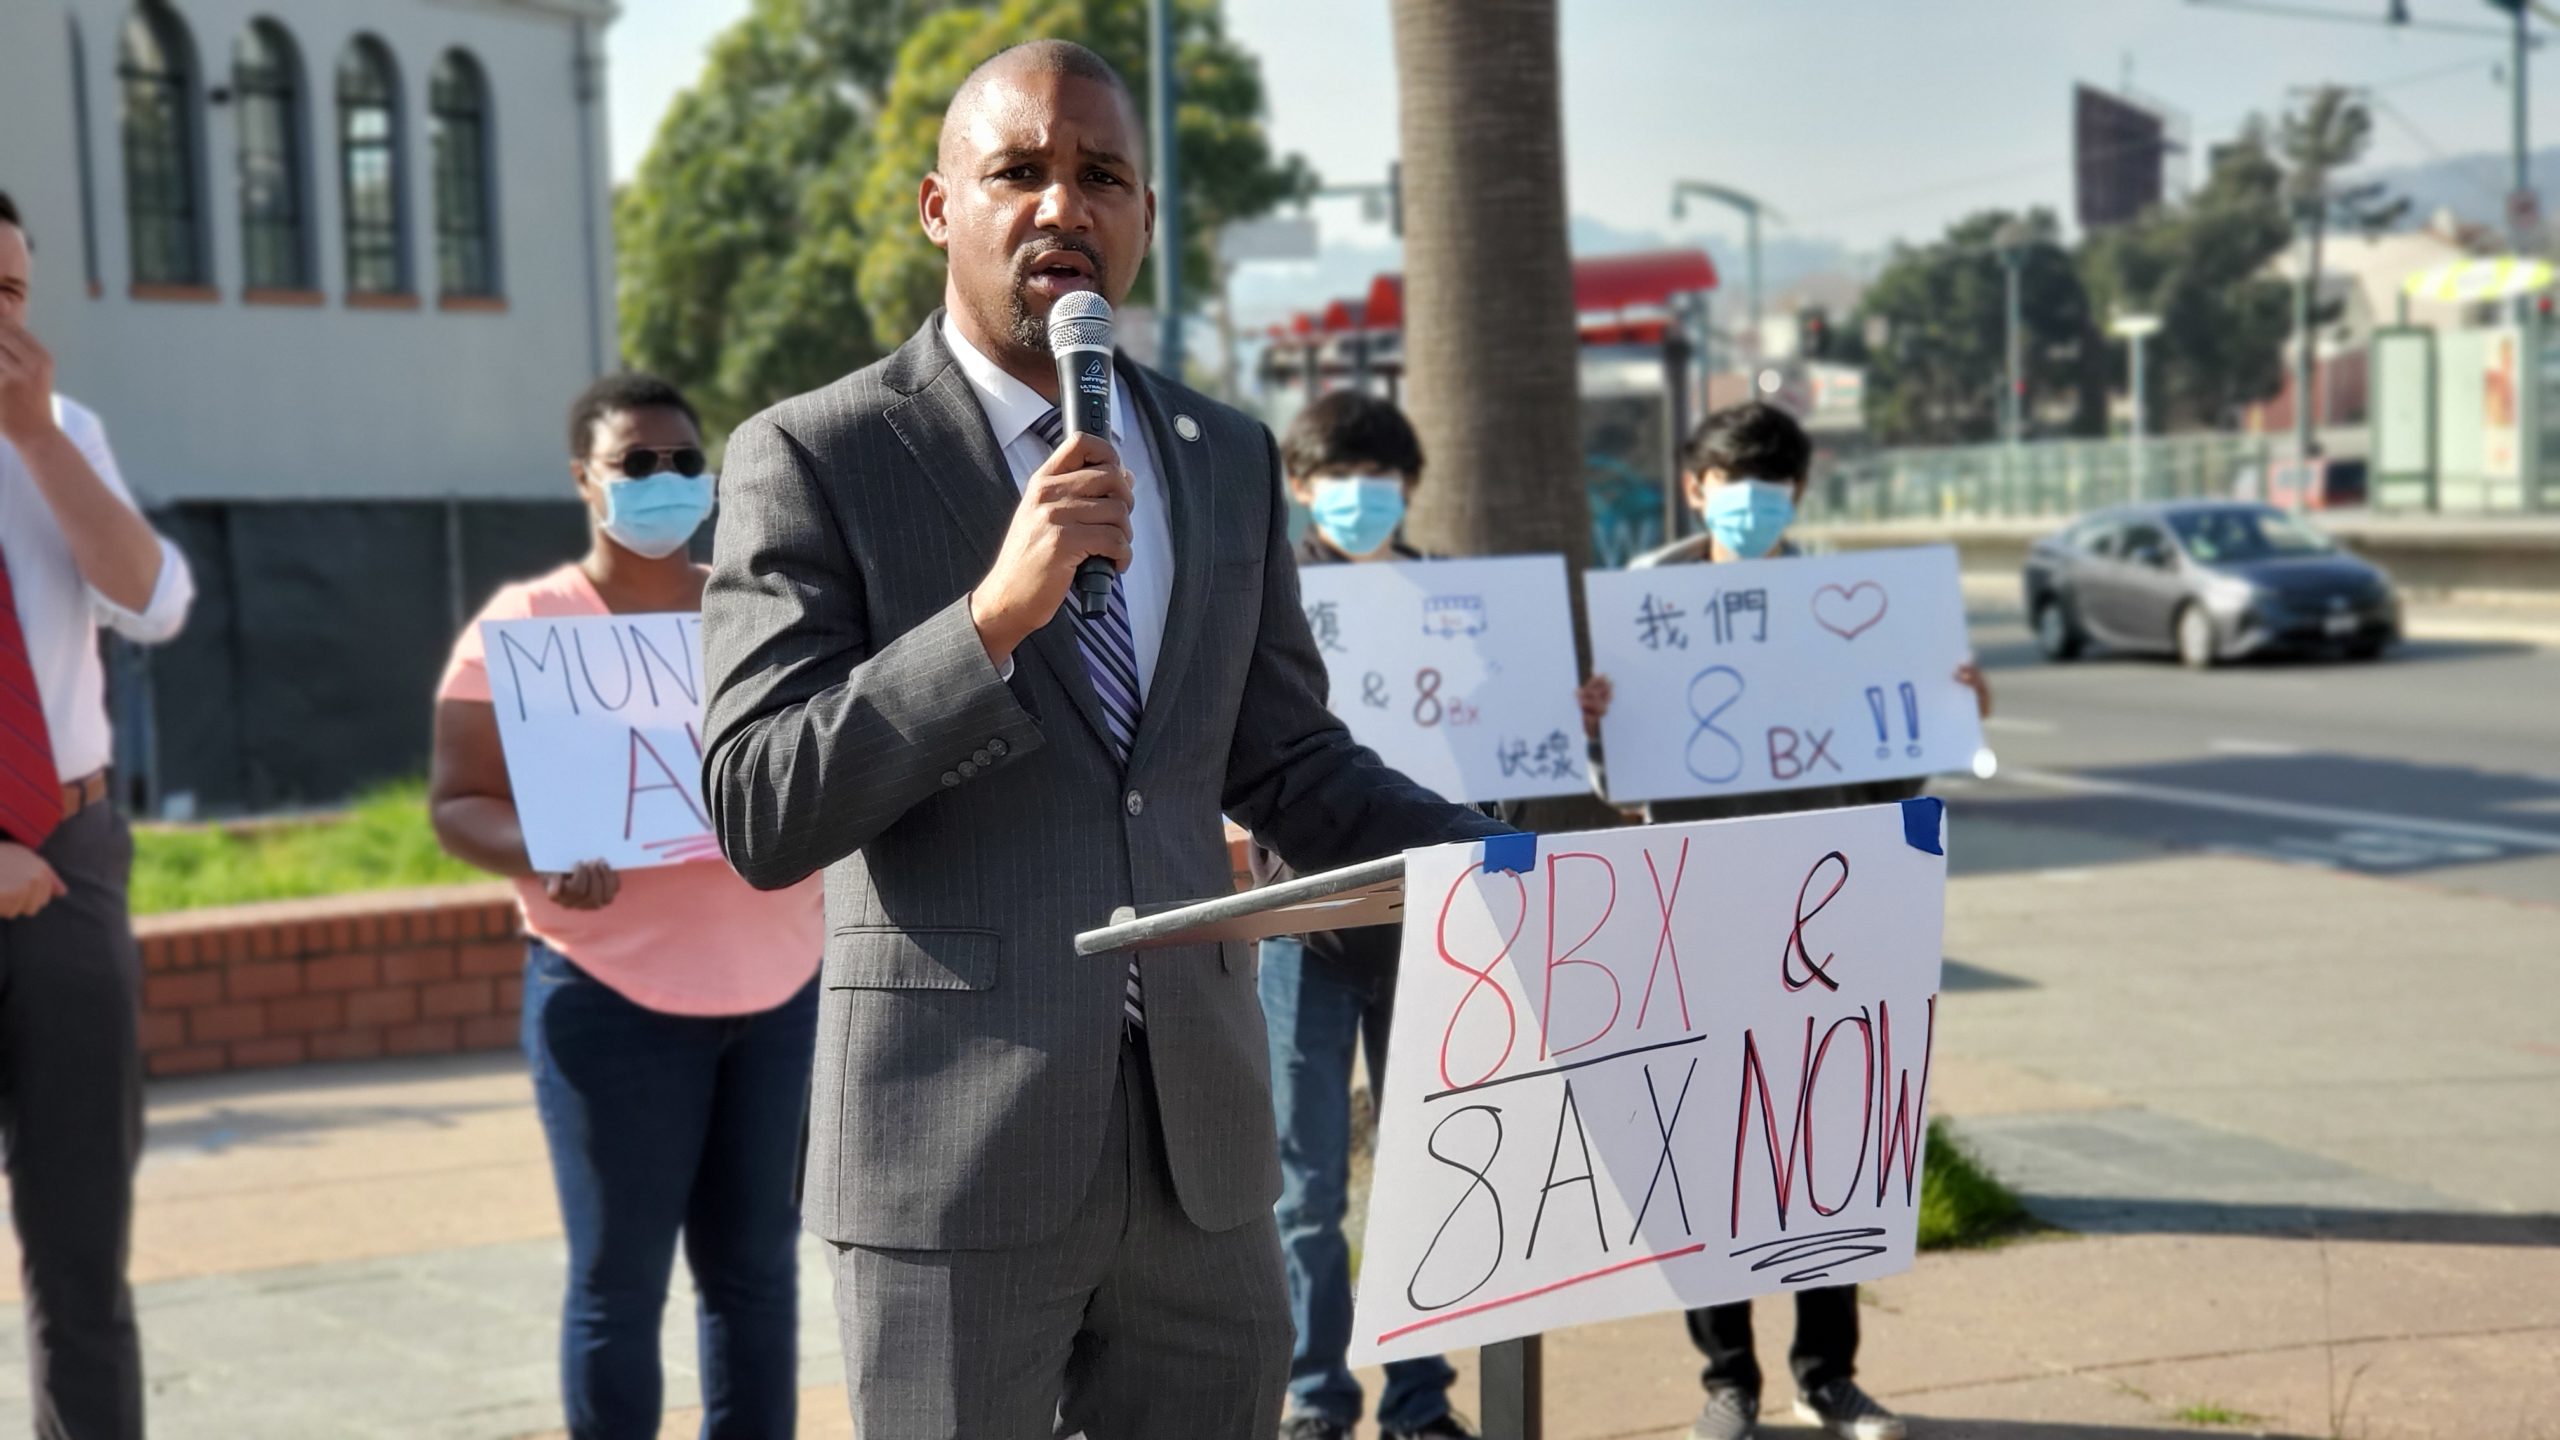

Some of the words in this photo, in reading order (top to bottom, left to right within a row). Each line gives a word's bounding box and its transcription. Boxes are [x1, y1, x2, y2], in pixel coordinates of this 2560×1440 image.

[499, 617, 702, 722] MUN
[1635, 587, 1769, 650] 我們
[1362, 671, 1389, 710] &
[1437, 836, 1692, 1091] 8BX
[1782, 850, 1850, 993] &
[1407, 1056, 1699, 1312] 8AX
[1730, 993, 1938, 1239] NOW
